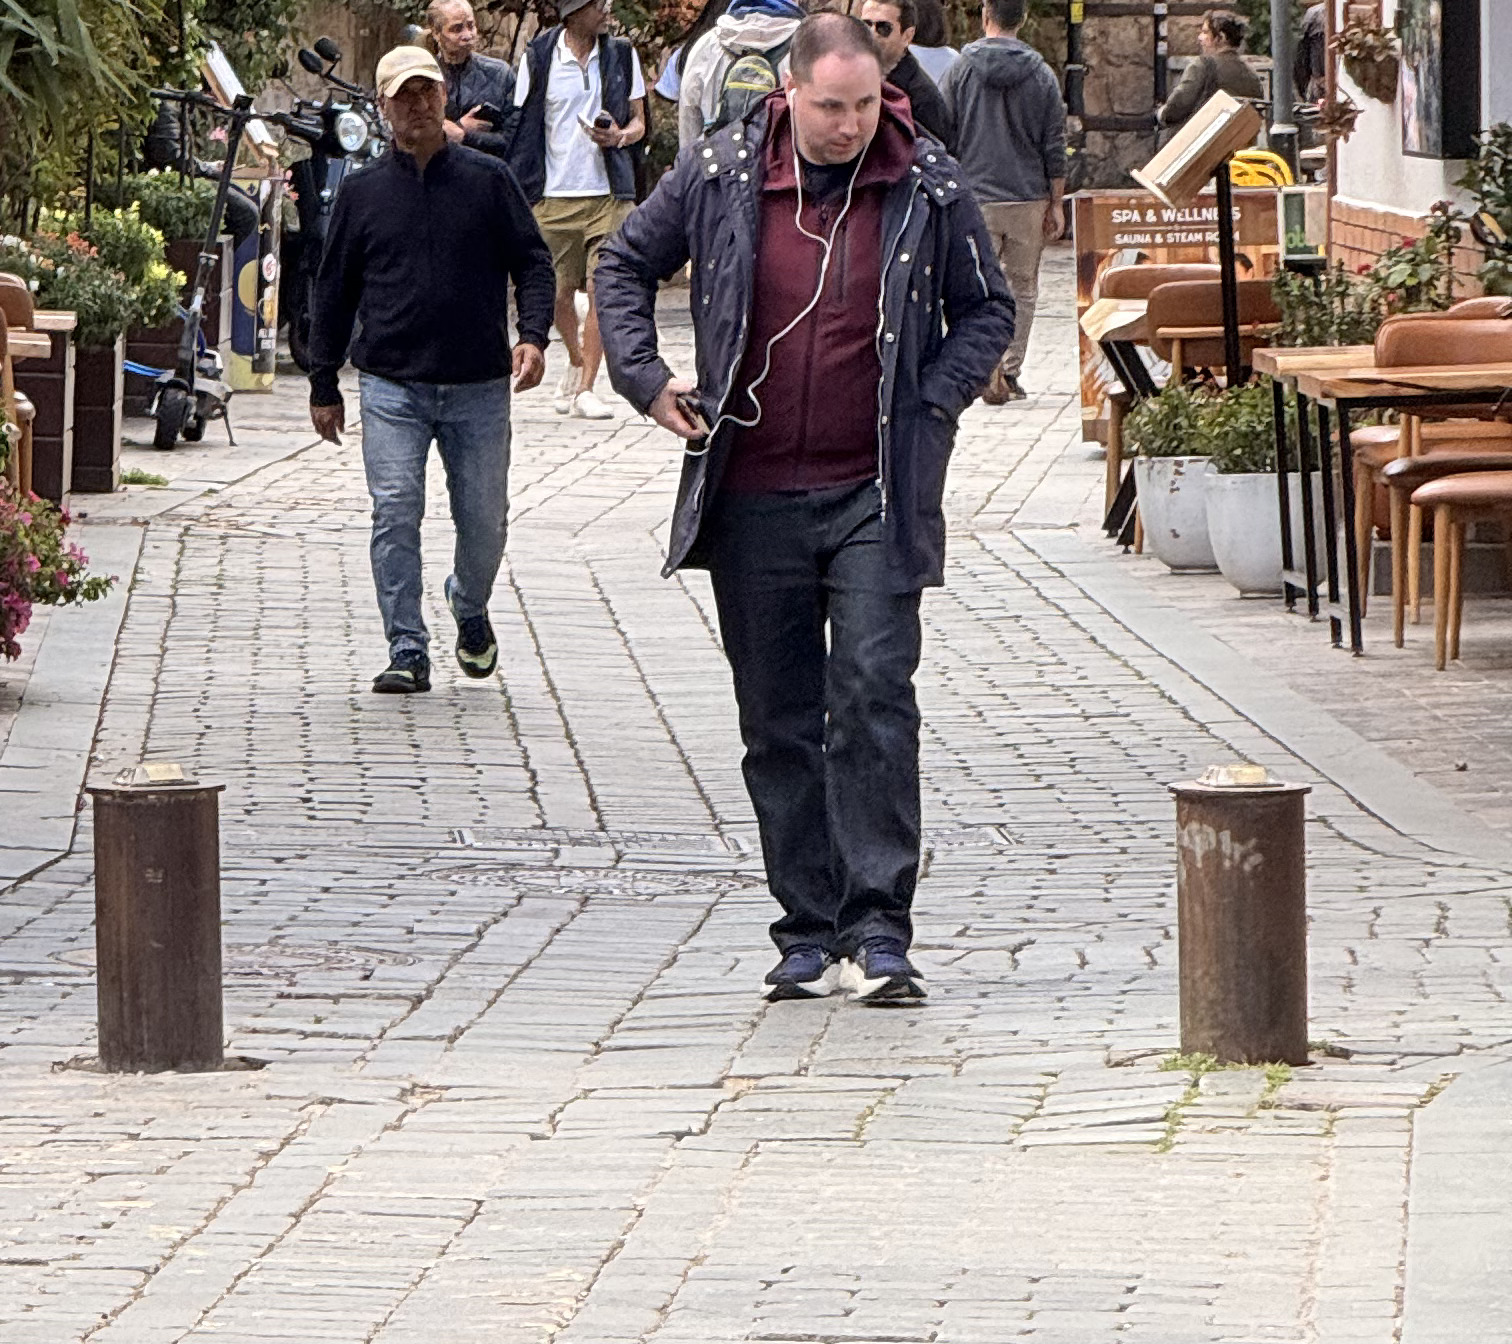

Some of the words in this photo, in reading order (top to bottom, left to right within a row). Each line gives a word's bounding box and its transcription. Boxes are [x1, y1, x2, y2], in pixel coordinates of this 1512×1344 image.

[1111, 209, 1141, 223] SPA
[1145, 208, 1157, 223] &
[1114, 233, 1152, 245] SAUNA
[1154, 232, 1164, 244] &
[1166, 231, 1203, 244] STEAM
